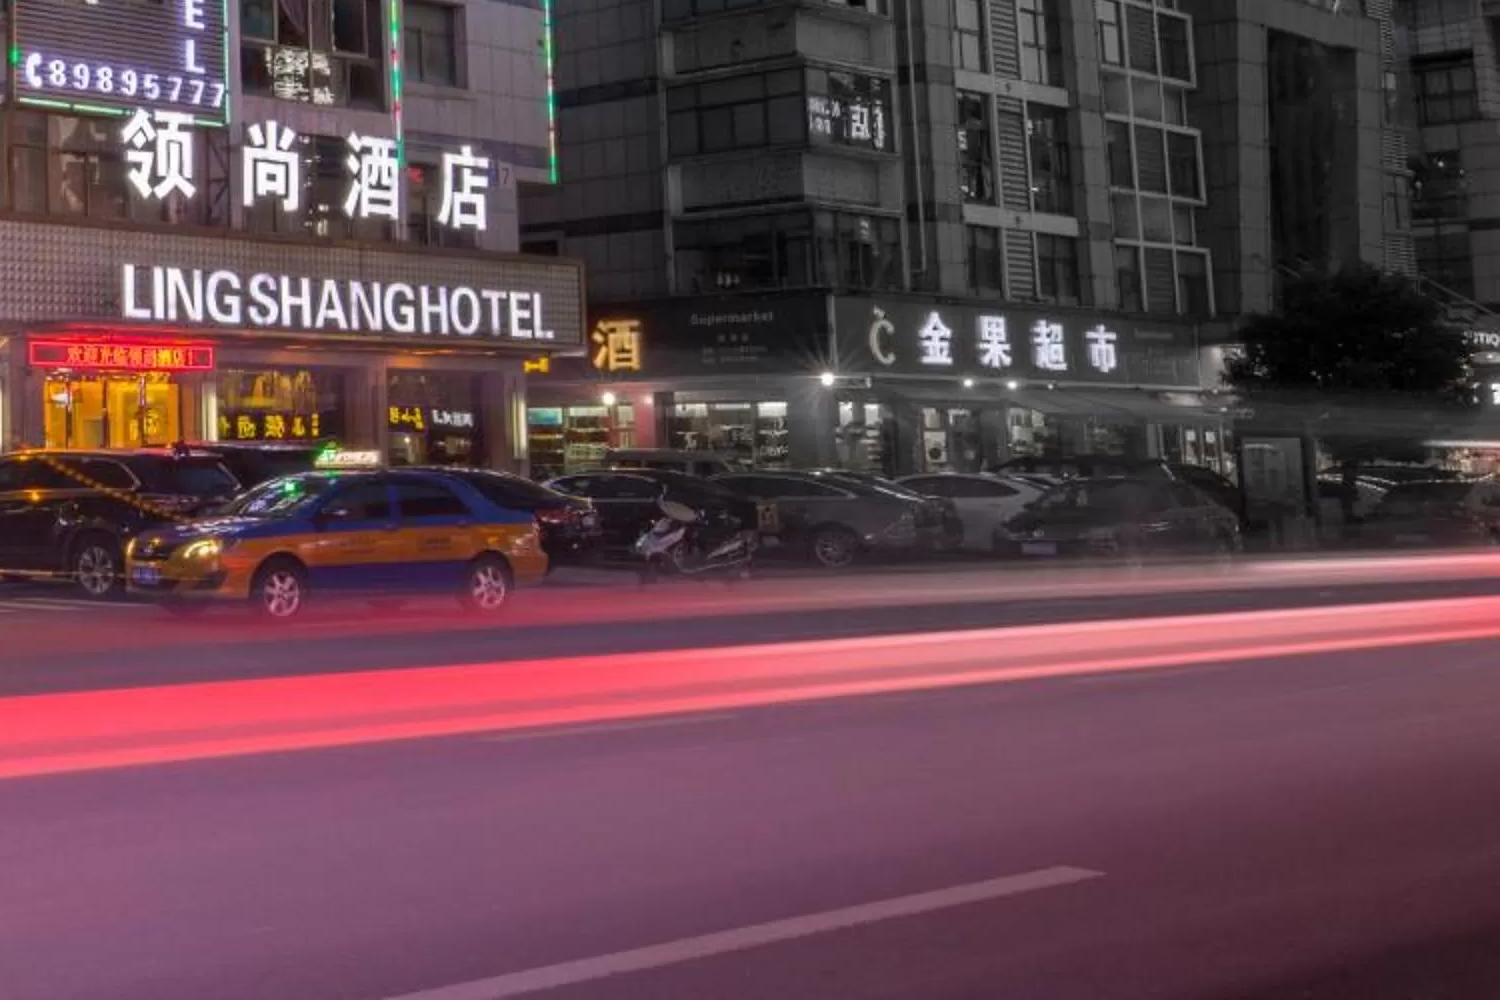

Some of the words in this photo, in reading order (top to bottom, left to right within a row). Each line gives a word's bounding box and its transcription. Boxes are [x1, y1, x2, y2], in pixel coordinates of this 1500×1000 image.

[121, 107, 489, 231] 领尚酒店
[122, 264, 555, 340] LINGSHANGHOTEL
[690, 310, 774, 327] Supermarket
[592, 319, 642, 371] 酒
[918, 310, 1118, 374] 金果超市
